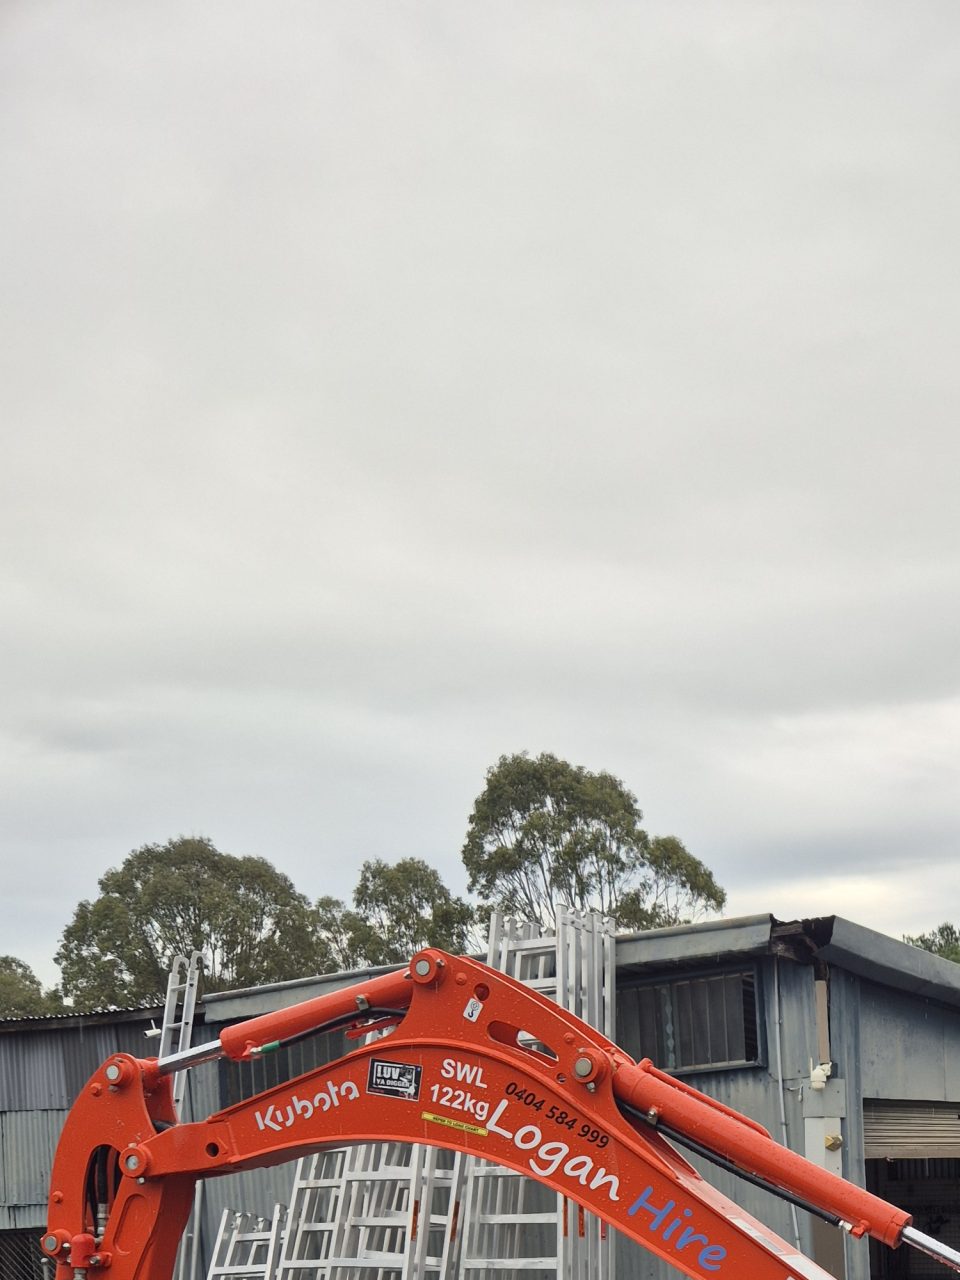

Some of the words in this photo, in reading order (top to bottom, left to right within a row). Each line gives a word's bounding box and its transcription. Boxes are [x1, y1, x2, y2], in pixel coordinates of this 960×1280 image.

[376, 1065, 400, 1080] LUV
[441, 1058, 488, 1089] SWL
[254, 1080, 360, 1132] Kubota
[430, 1083, 490, 1121] 122kg
[505, 1082, 546, 1112] 0404
[545, 1105, 579, 1130] 584
[578, 1124, 610, 1148] 999
[485, 1099, 620, 1201] Logan
[627, 1186, 727, 1271] Hire
